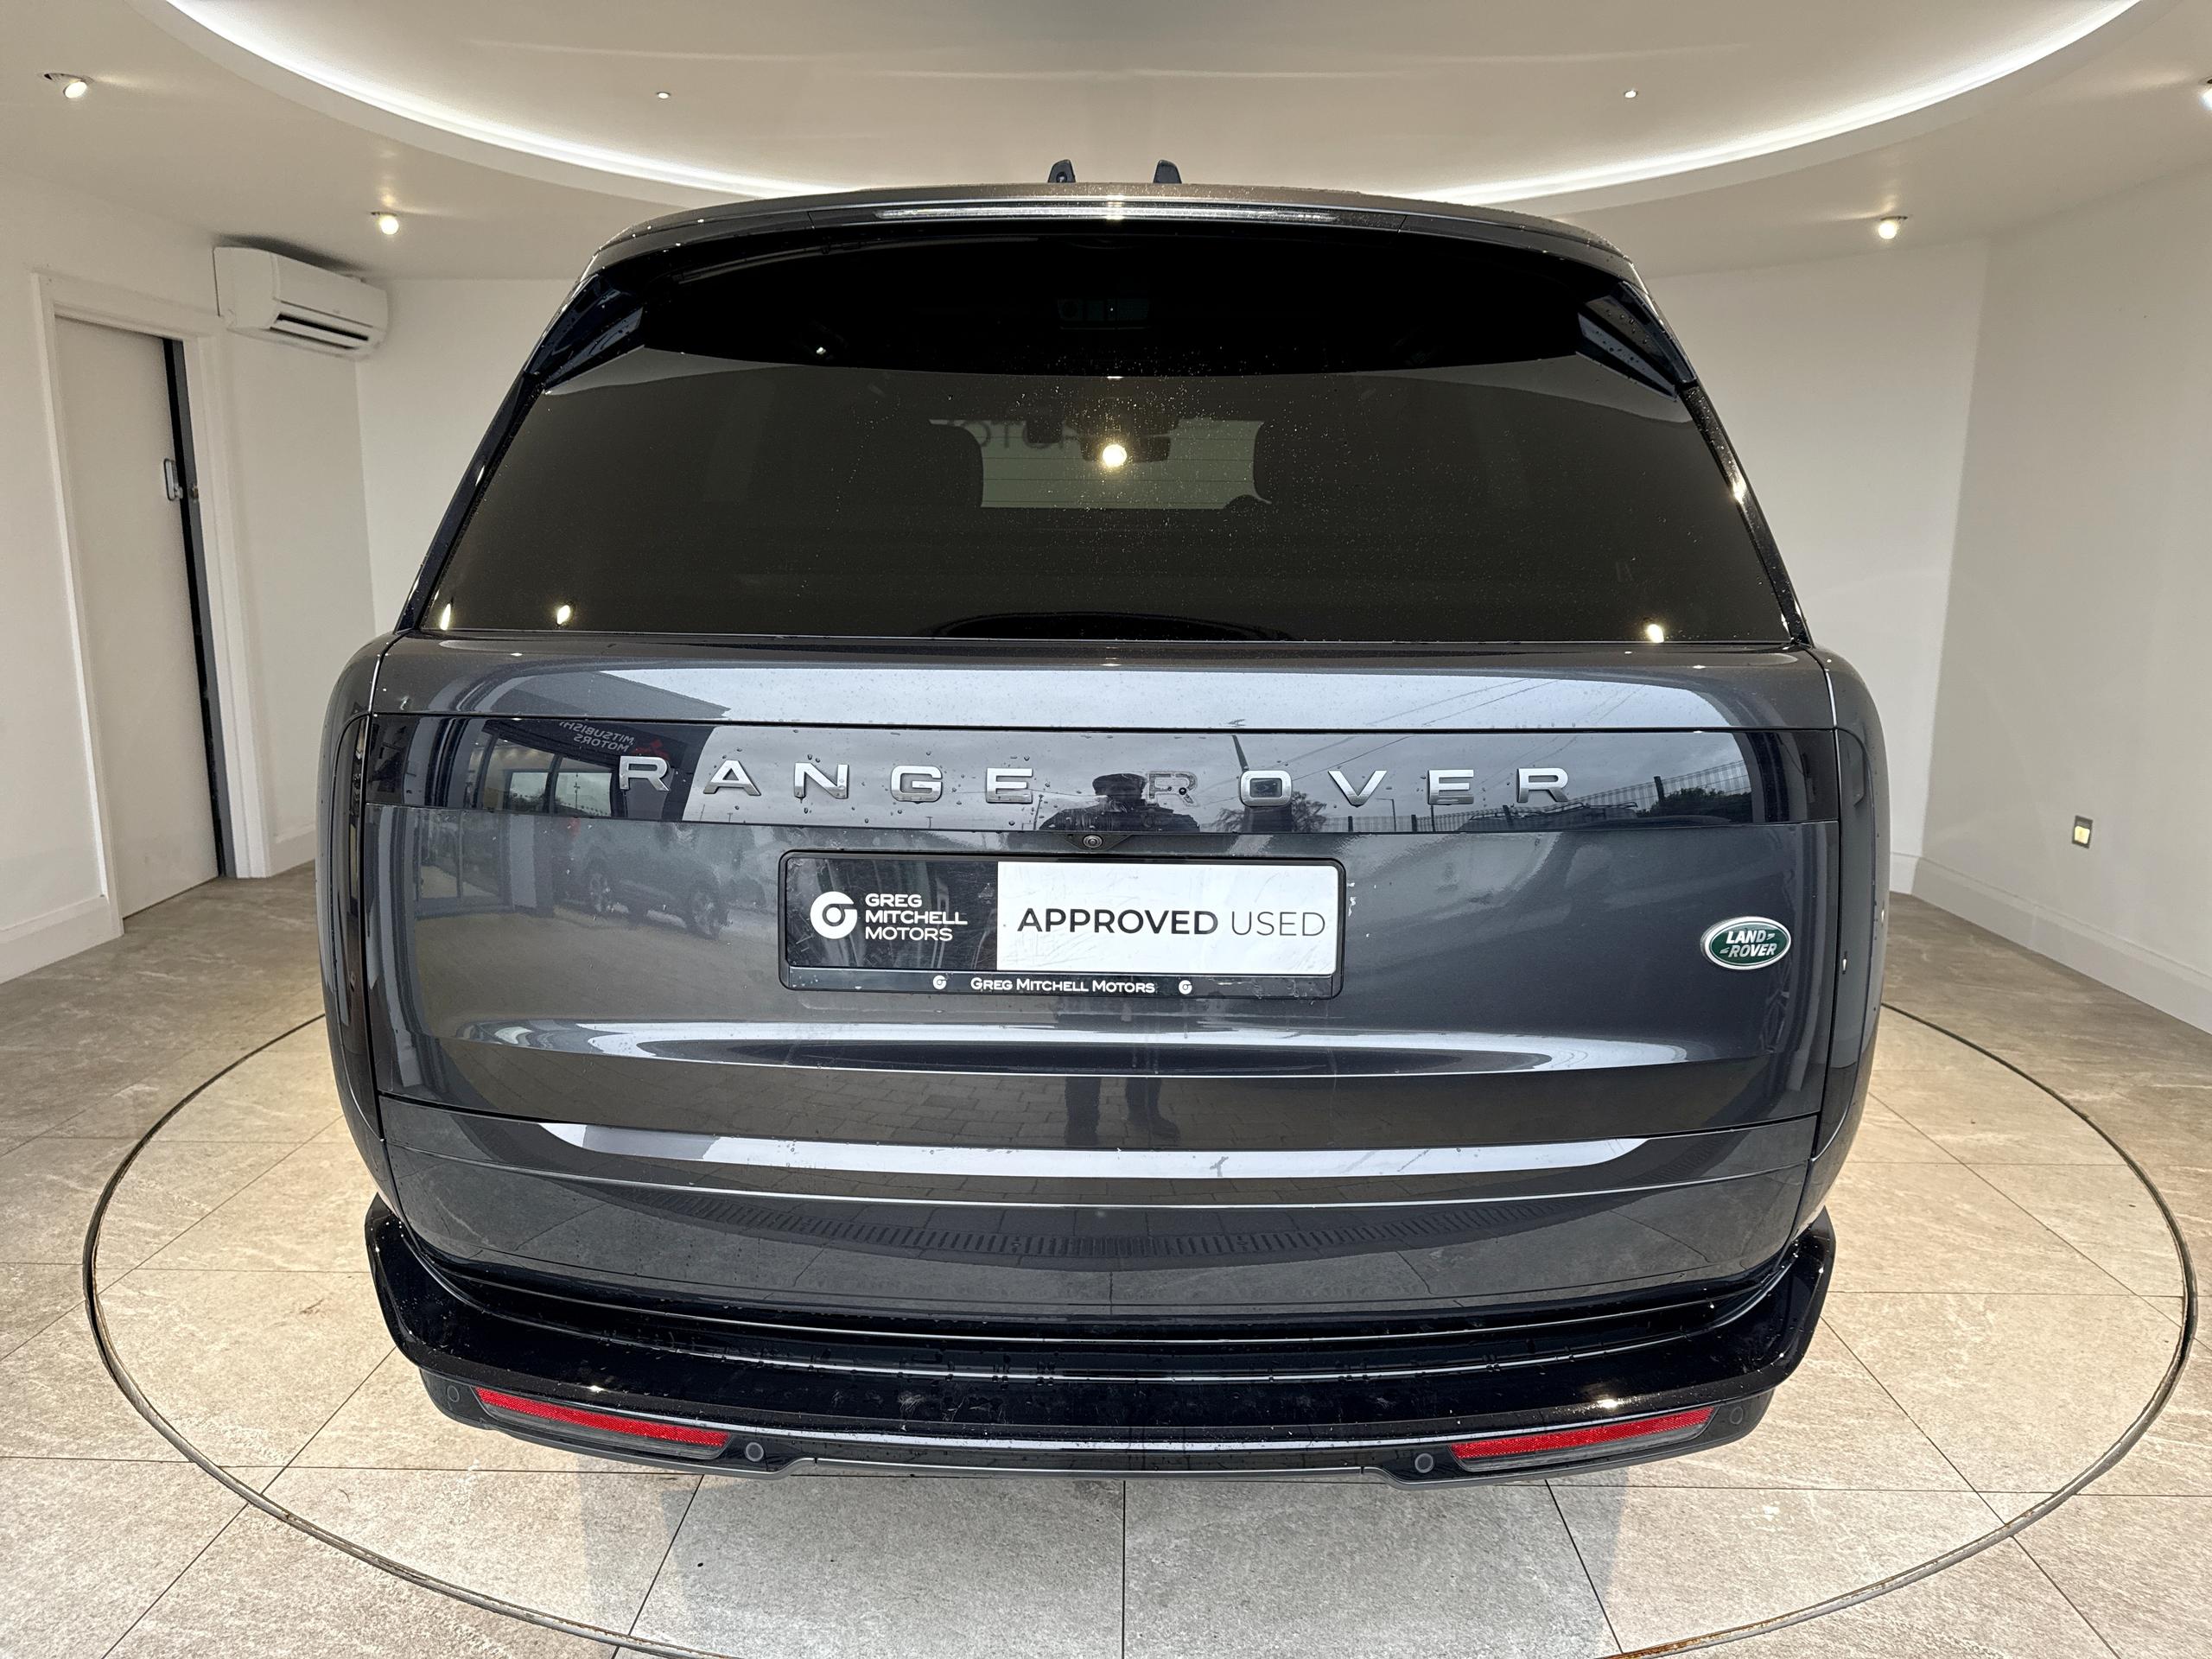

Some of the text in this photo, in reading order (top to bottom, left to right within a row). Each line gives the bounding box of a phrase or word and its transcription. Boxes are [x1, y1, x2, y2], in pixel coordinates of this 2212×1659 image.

[619, 754, 1569, 808] RANGE ROVER
[865, 893, 923, 907] GREG
[865, 910, 968, 925] MITCHELL
[1017, 907, 1325, 937] APPROVED USED
[865, 927, 953, 941] MOTORS
[1726, 930, 1767, 944] LAND
[1728, 943, 1777, 957] ROVER
